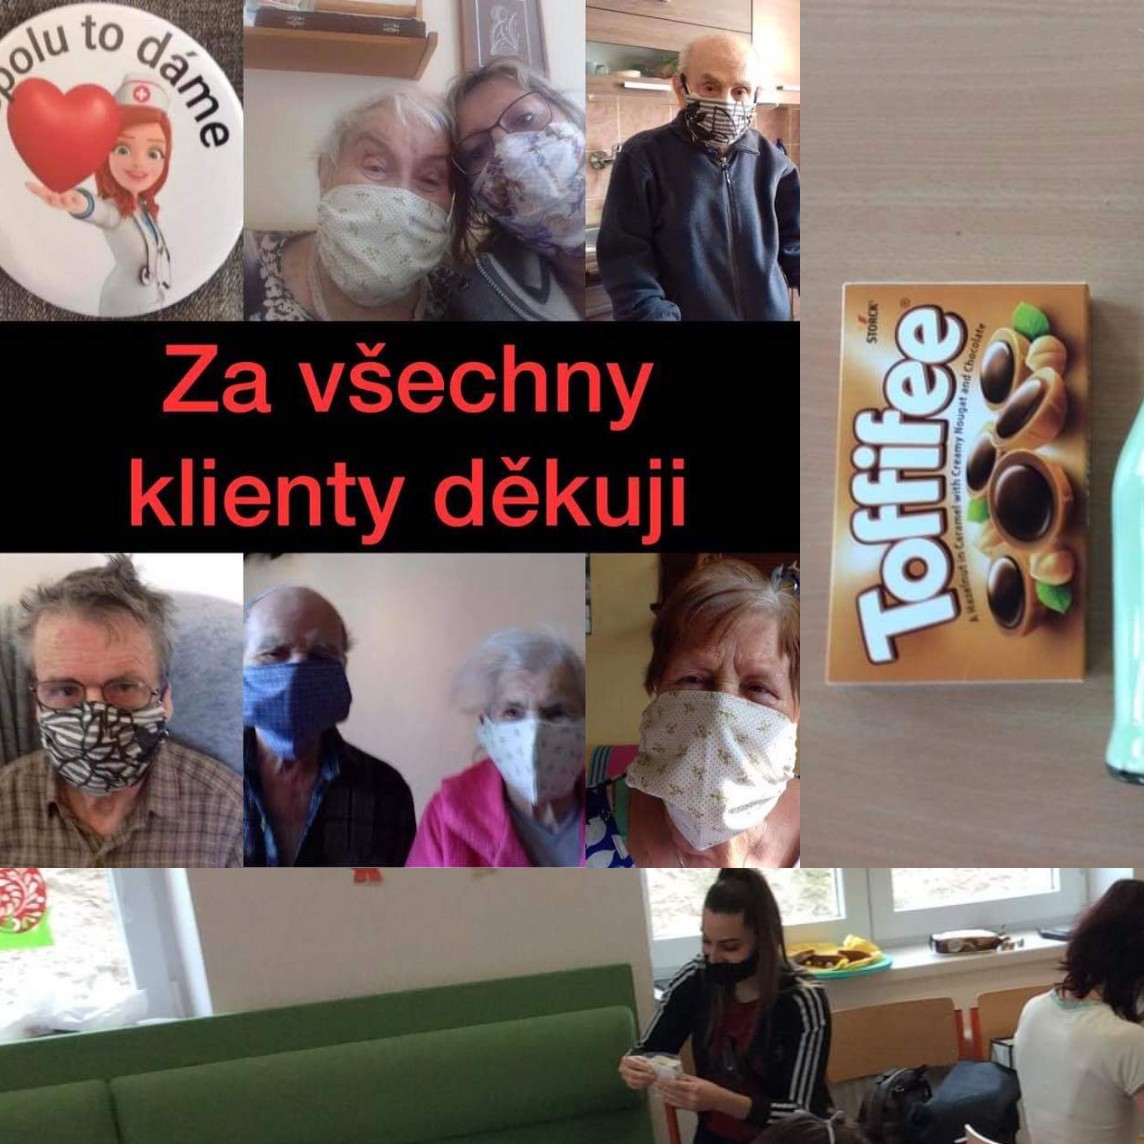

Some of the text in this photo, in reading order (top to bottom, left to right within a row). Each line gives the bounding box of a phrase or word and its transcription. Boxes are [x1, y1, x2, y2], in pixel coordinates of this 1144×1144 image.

[81, 15, 124, 52] to
[137, 31, 229, 148] dáme
[962, 322, 987, 372] Chocolate
[954, 396, 969, 433] Nougat
[950, 436, 965, 478] Creamy
[851, 303, 968, 664] Toffifee
[951, 478, 961, 503] with
[952, 504, 963, 549] Caramel
